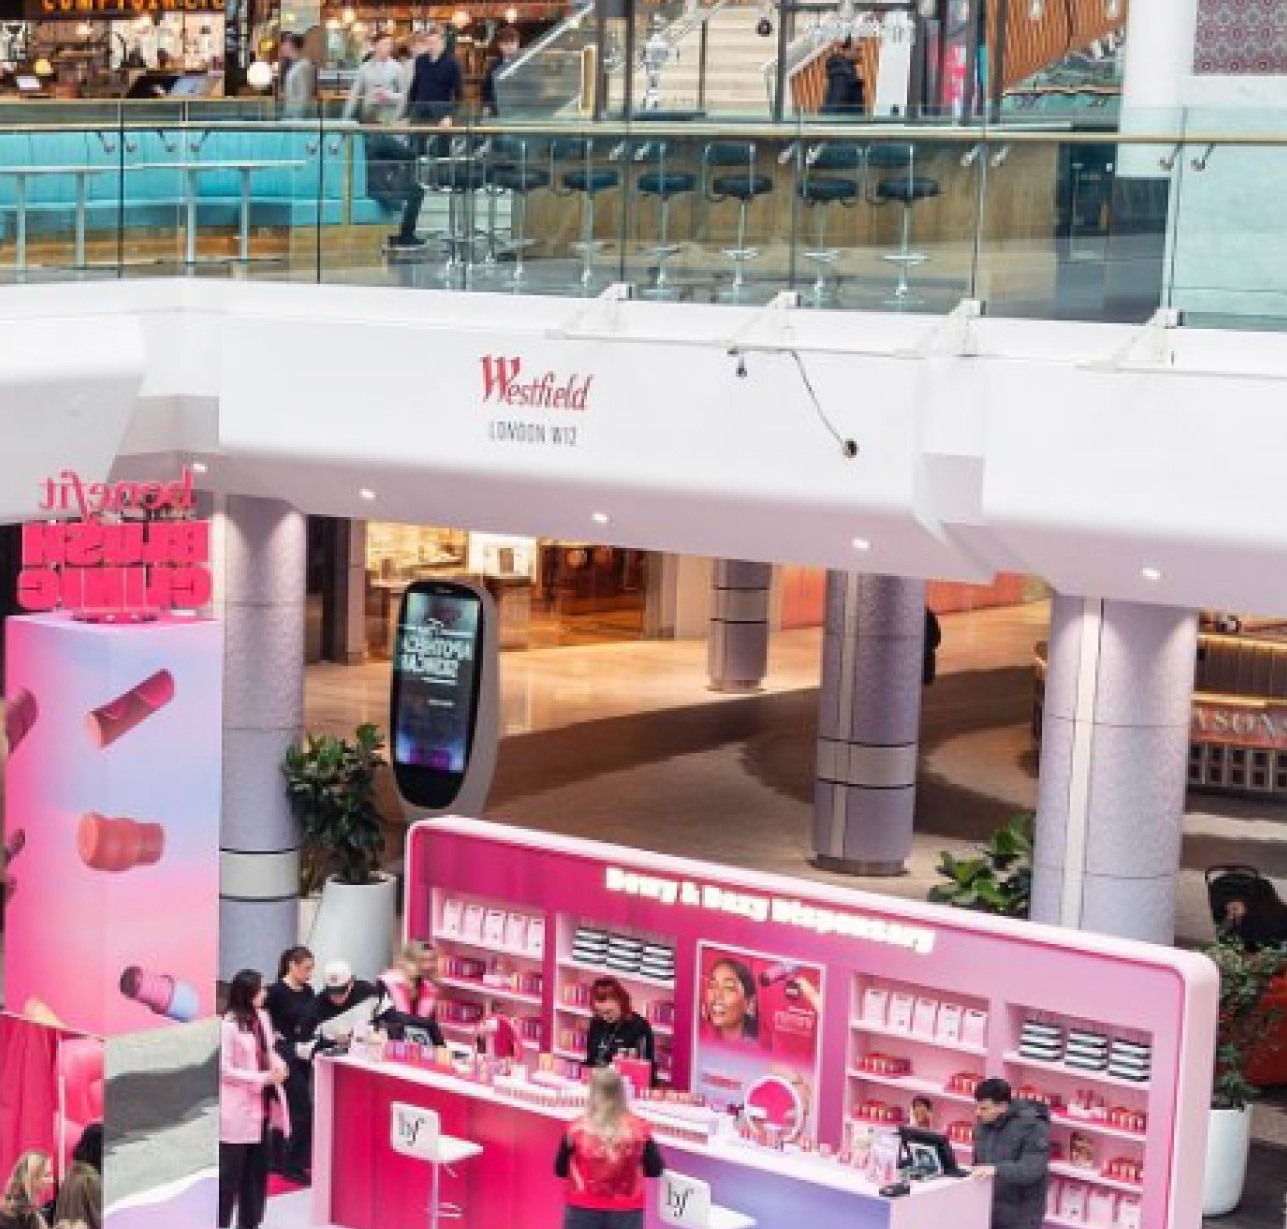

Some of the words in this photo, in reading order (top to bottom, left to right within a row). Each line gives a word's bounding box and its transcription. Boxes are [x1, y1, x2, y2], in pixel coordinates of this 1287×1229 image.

[479, 354, 594, 410] Westfield
[489, 421, 545, 444] LONDON
[552, 426, 577, 447] W12
